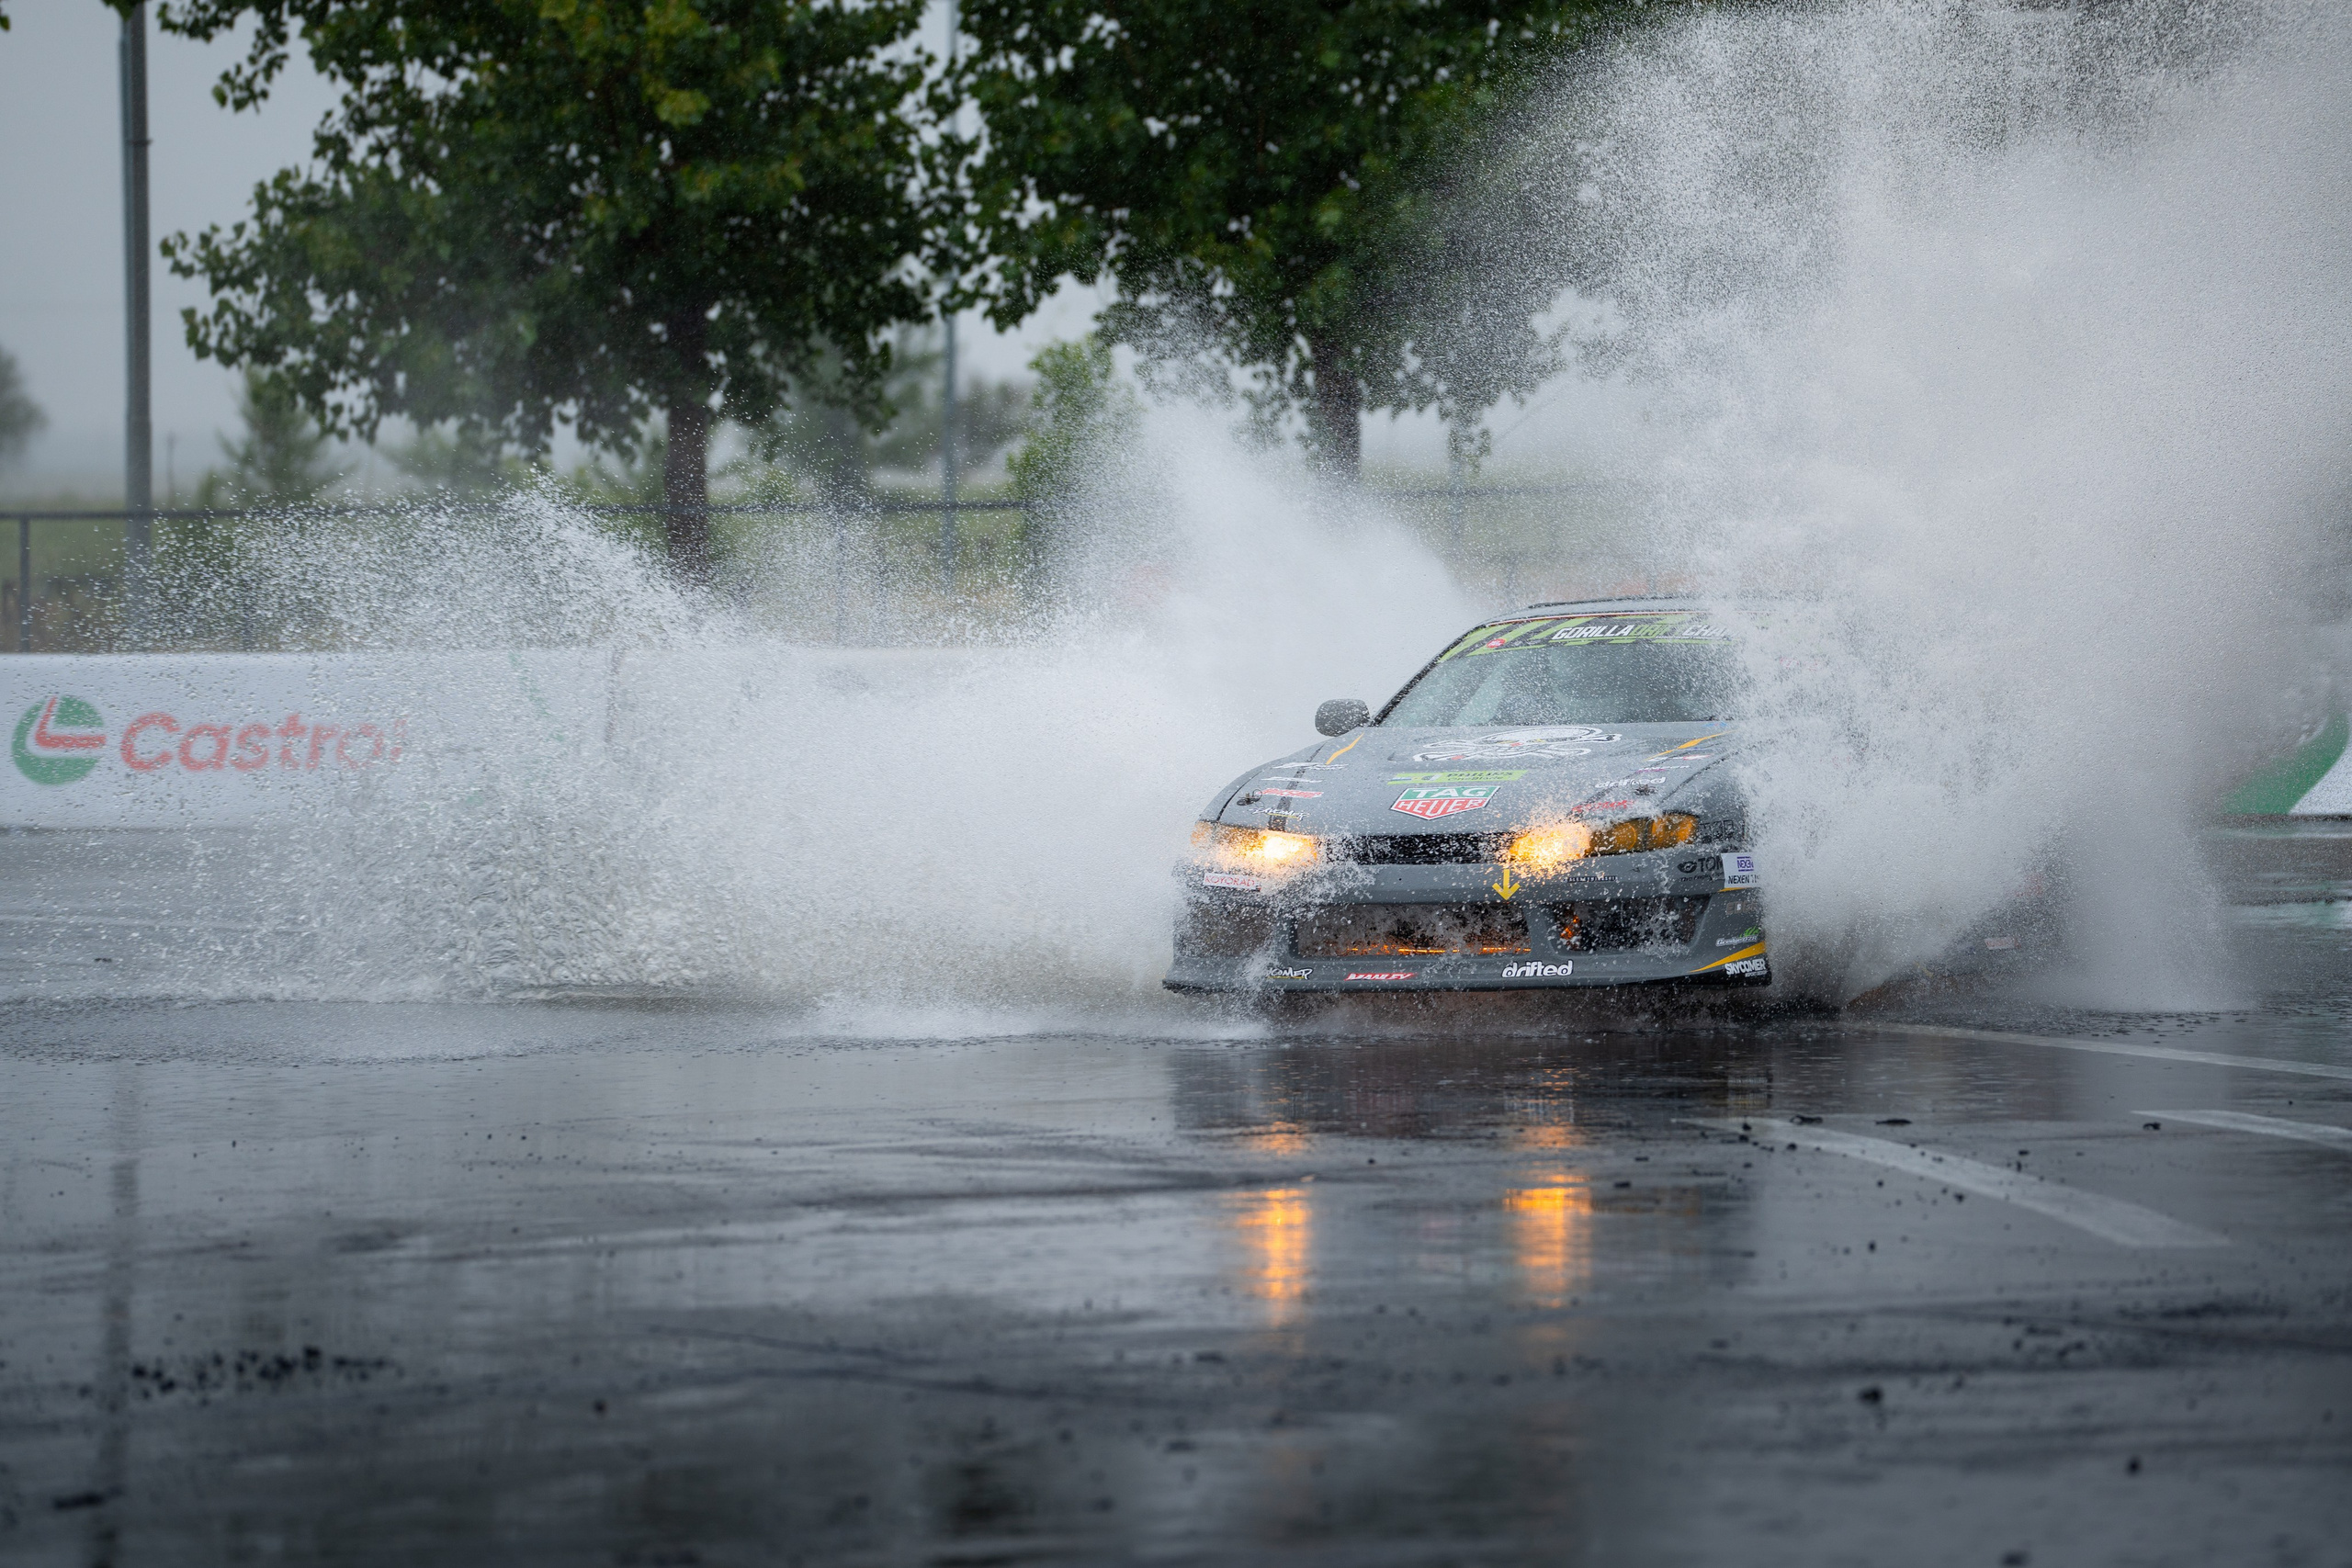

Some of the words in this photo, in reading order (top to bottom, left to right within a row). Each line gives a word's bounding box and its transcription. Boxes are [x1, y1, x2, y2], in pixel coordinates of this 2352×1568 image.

[1412, 787, 1487, 798] TAG
[1397, 799, 1480, 816] HEUER
[1727, 874, 1749, 885] NEXEN
[1501, 959, 1574, 978] drifted
[1724, 958, 1766, 976] SKYCOMER
